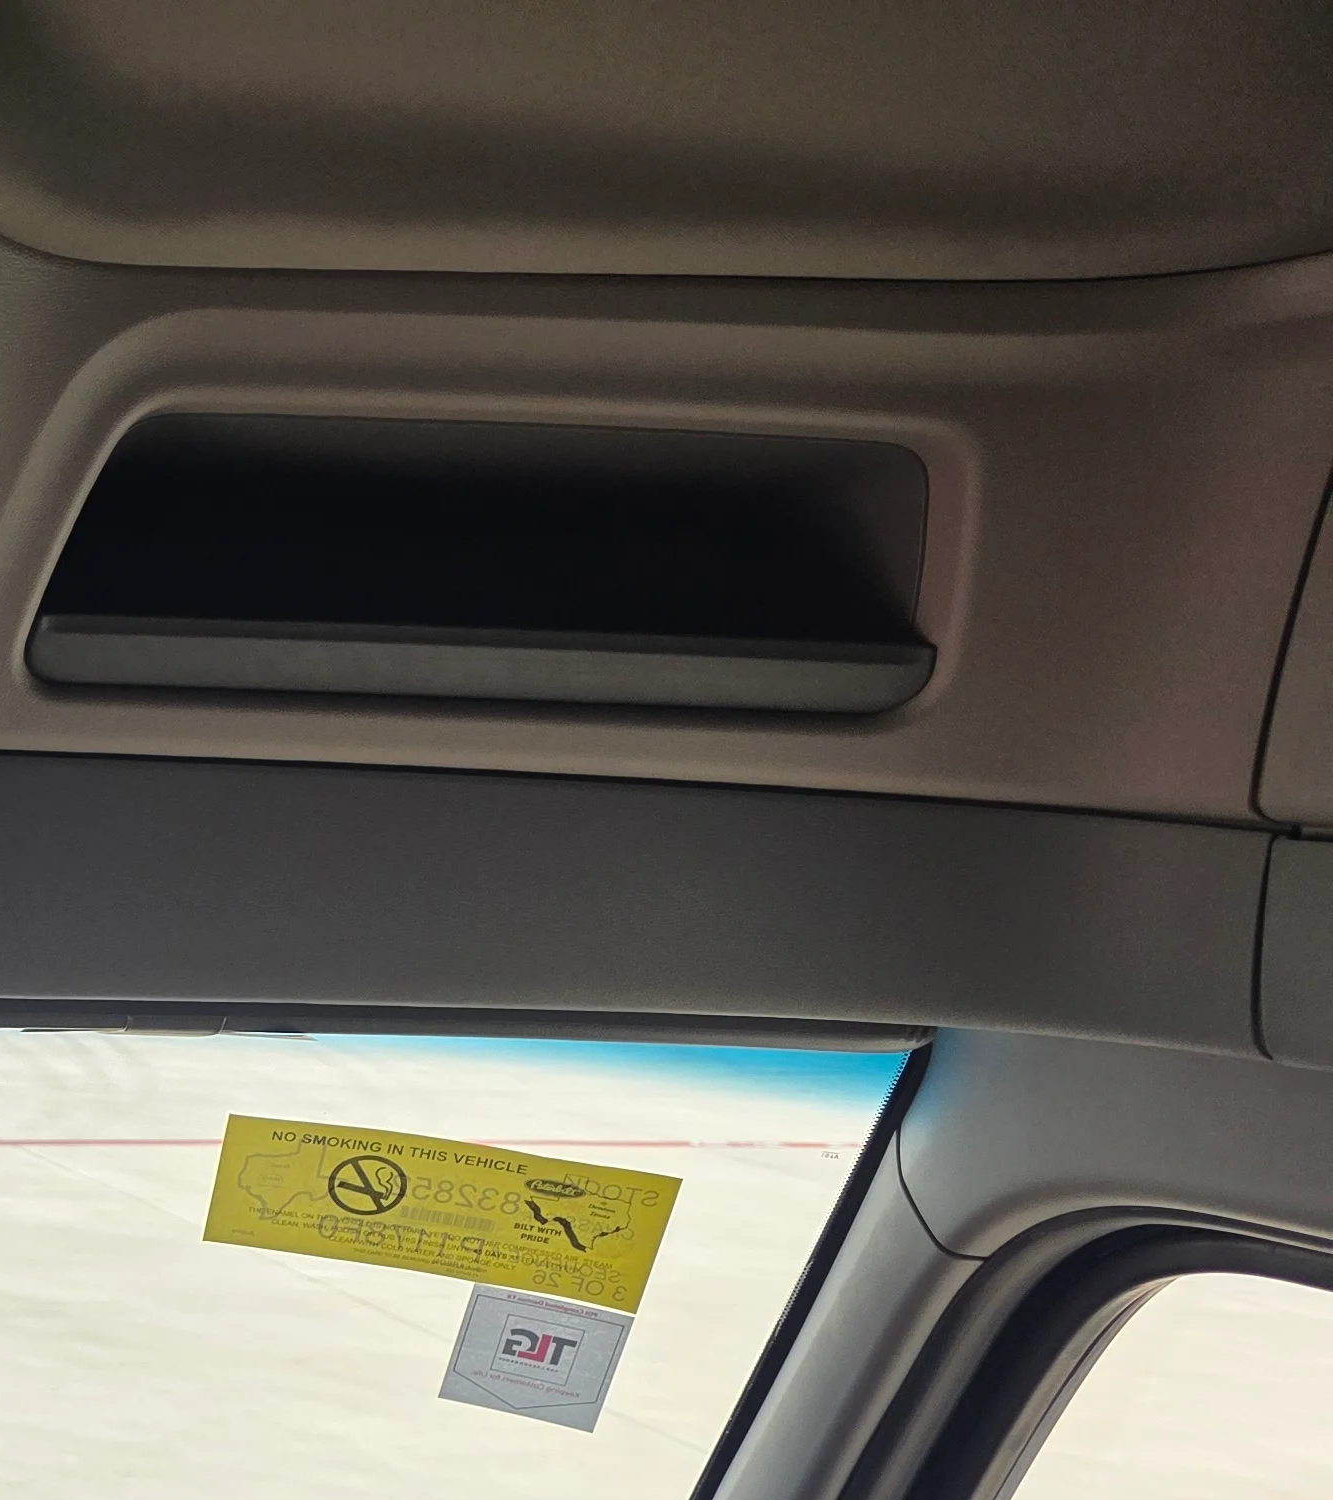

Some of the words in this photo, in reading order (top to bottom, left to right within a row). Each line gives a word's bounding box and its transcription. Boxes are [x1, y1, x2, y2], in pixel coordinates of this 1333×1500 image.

[271, 1131, 296, 1142] NO
[301, 1133, 381, 1152] SMOKING
[387, 1144, 403, 1156] IN
[409, 1146, 447, 1162] THIS
[453, 1153, 529, 1174] VEHICLE
[530, 1180, 582, 1197] Peterbilt
[514, 1222, 535, 1232] BILT
[537, 1226, 562, 1236] WITH
[520, 1234, 550, 1244] PRIDE
[483, 1250, 508, 1259] DAYS
